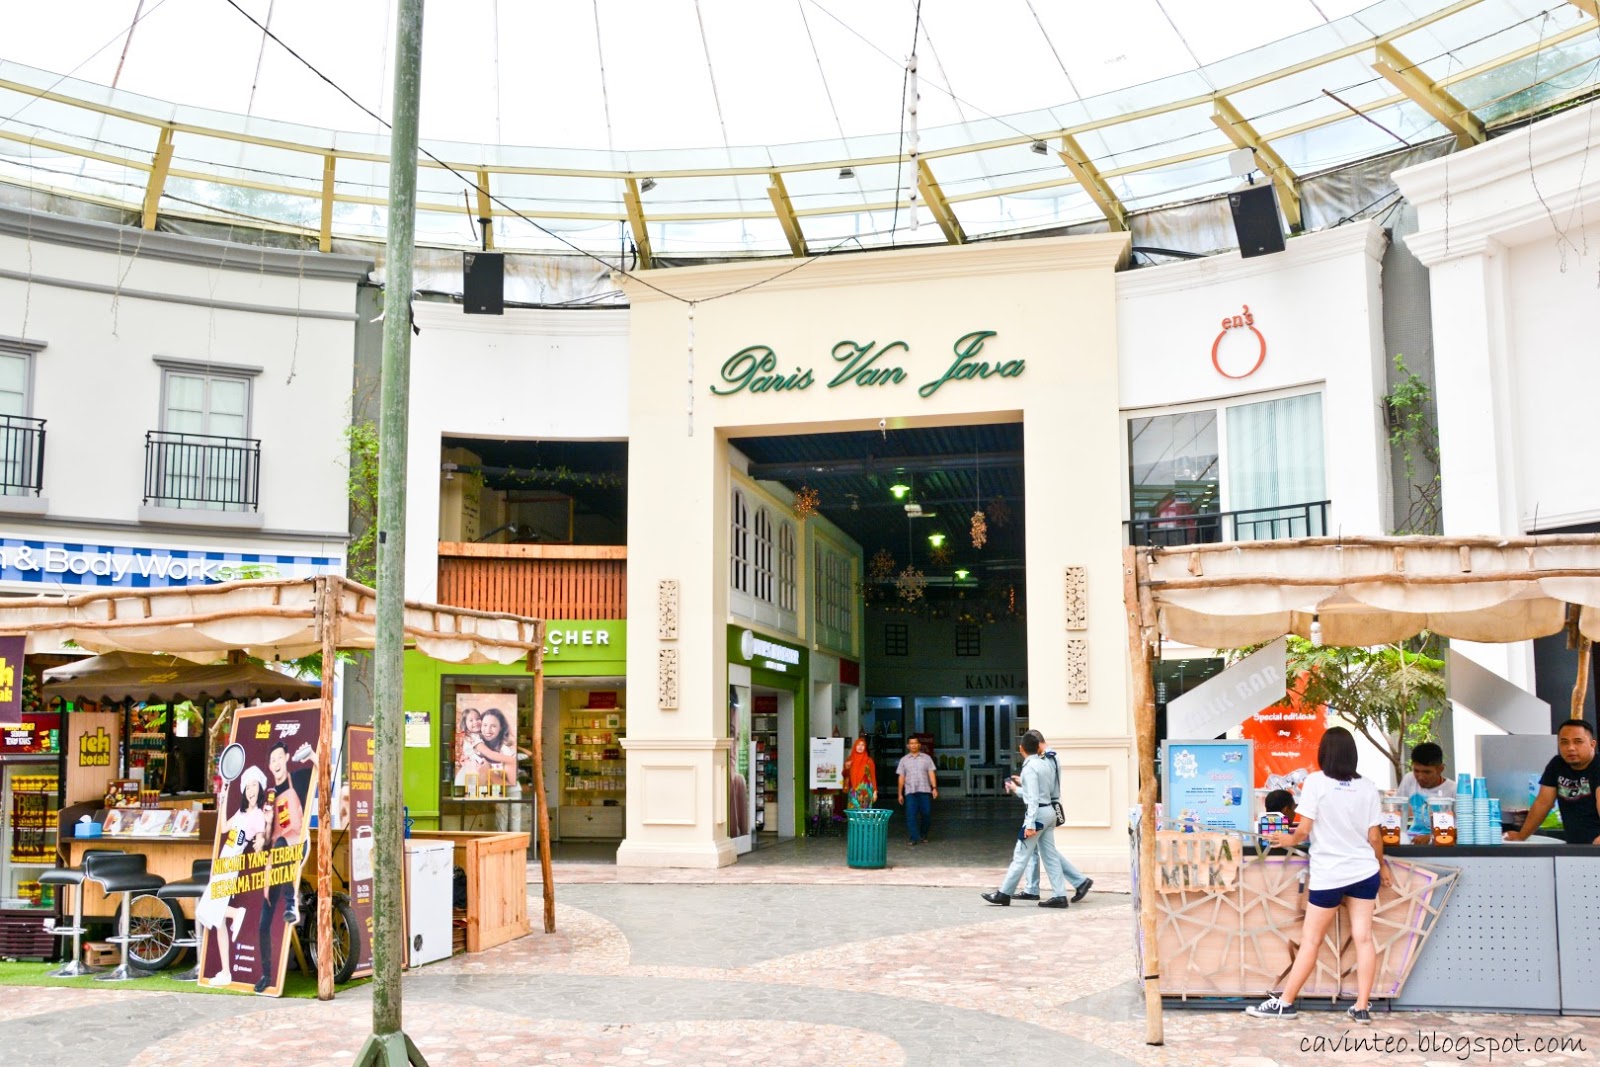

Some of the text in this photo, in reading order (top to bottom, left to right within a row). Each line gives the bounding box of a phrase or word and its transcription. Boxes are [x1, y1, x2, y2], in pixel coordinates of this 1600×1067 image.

[1221, 304, 1254, 329] en's
[709, 330, 1026, 399] Paris Van Java
[13, 545, 39, 572] &
[45, 547, 131, 582] Body
[135, 553, 234, 582] Works
[548, 630, 610, 645] CHER
[965, 673, 1015, 689] KANINI
[1235, 665, 1281, 700] BAR
[1253, 713, 1282, 723] Special
[79, 727, 110, 753] teh
[79, 753, 110, 766] kotak
[212, 843, 305, 875] NIKMATI YANG TERBAIK
[1155, 839, 1233, 862] ULTRA
[211, 863, 297, 900] BERSAMA TEH KOTAK
[1160, 863, 1227, 888] MILK
